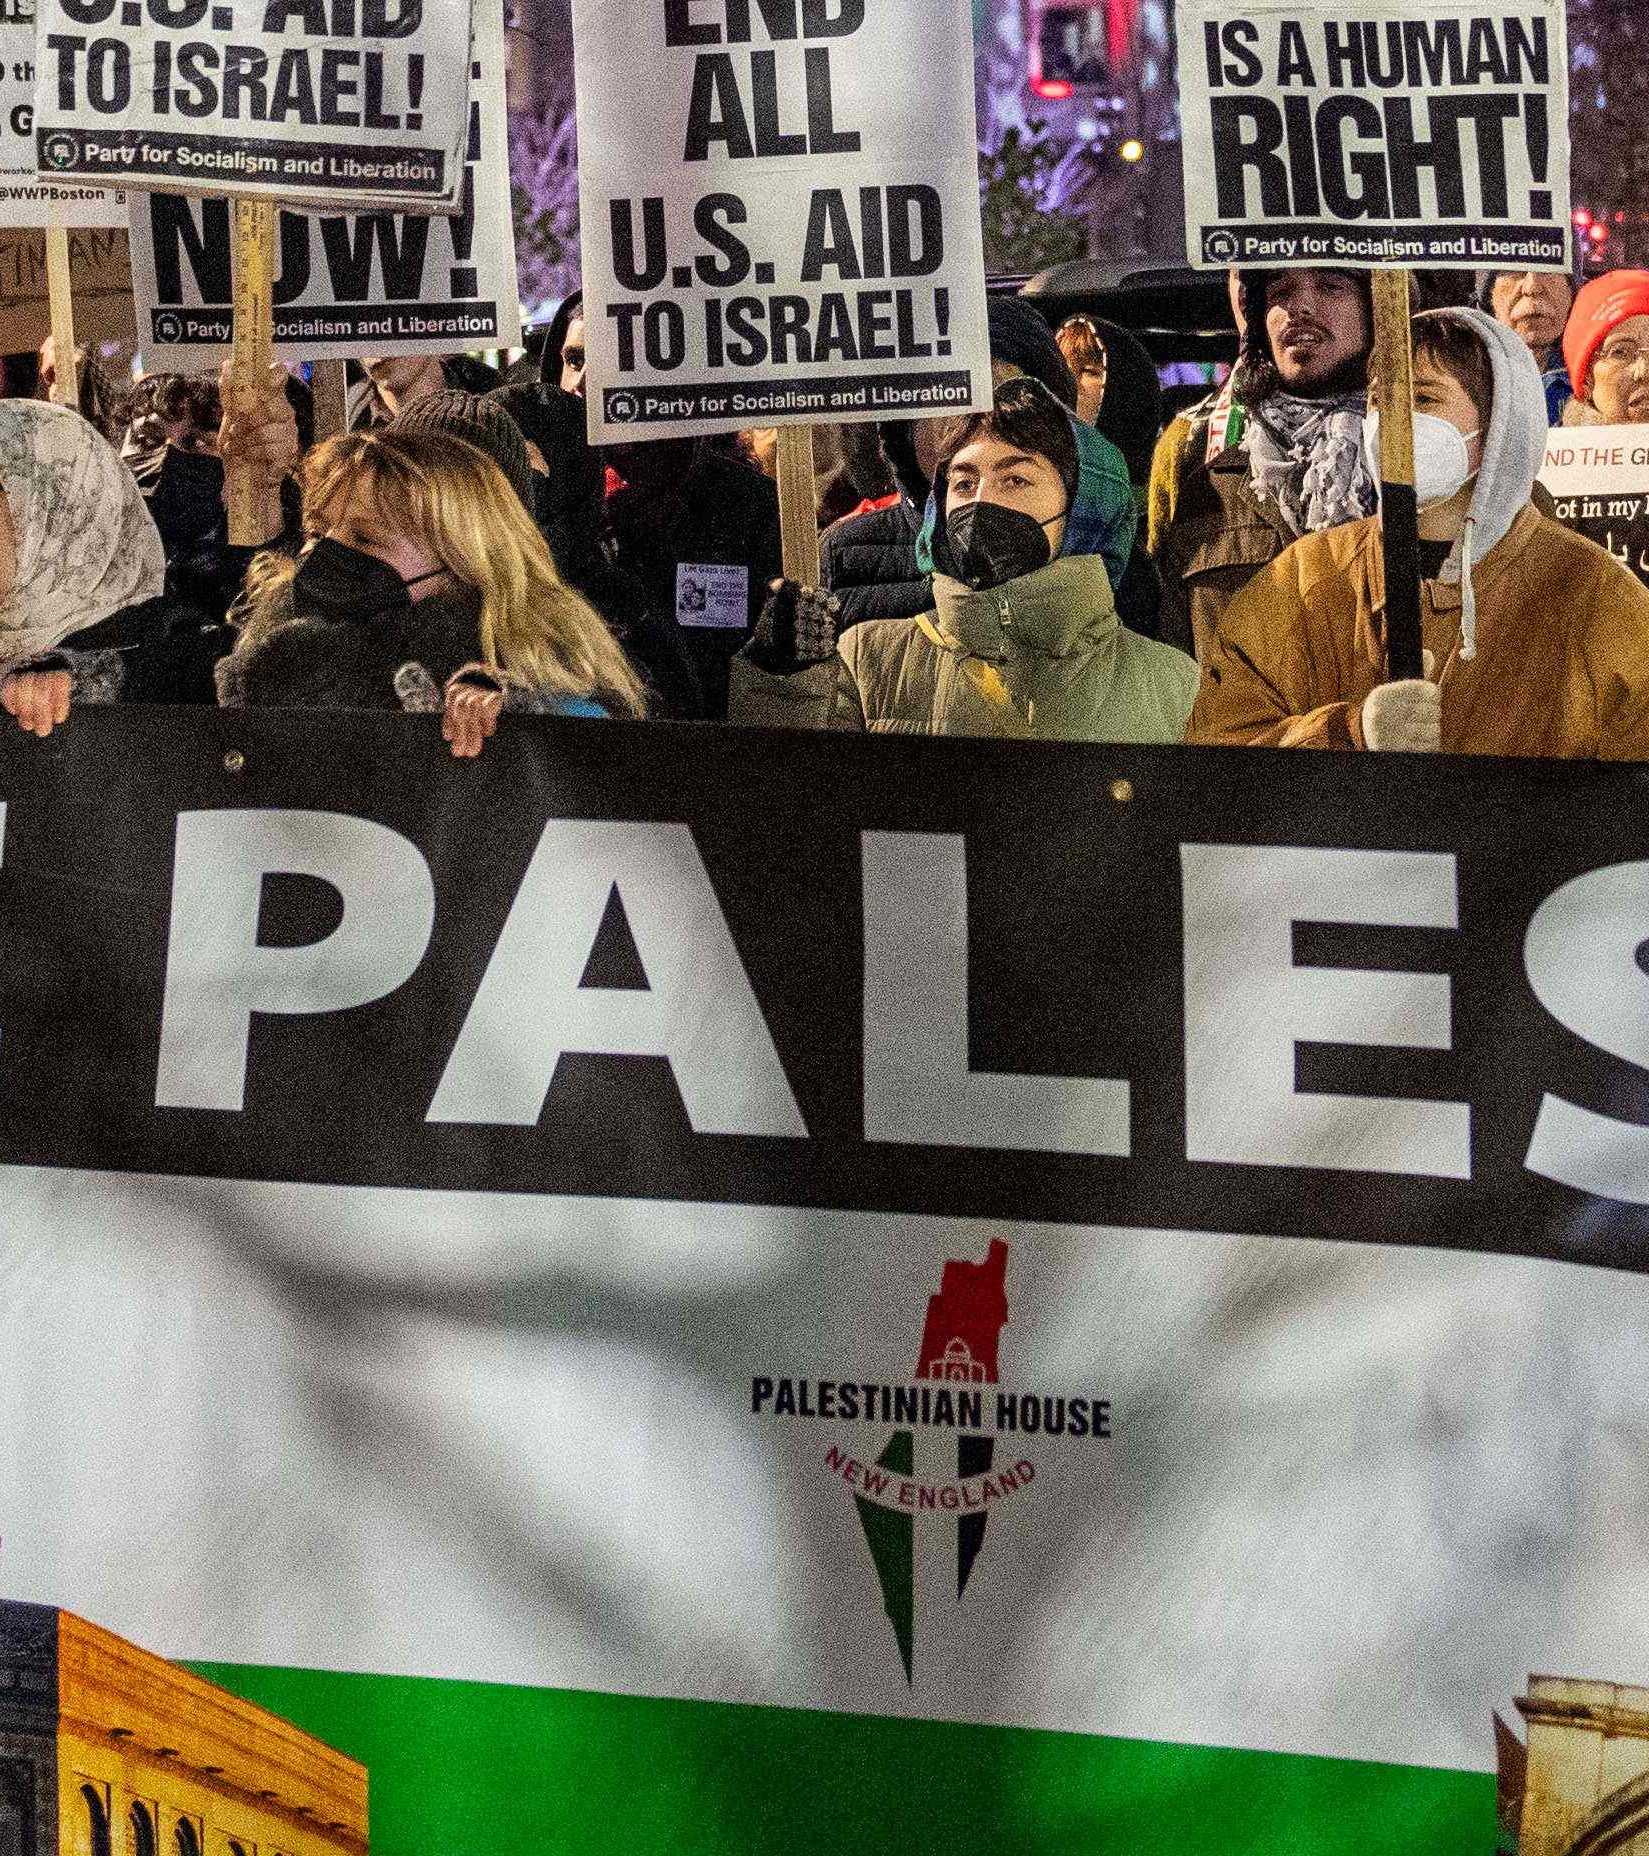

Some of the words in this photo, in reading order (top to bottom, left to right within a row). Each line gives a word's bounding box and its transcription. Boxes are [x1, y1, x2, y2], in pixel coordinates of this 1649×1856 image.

[13, 61, 35, 82] th
[1203, 20, 1263, 87] IS
[1277, 20, 1315, 86] A
[1325, 17, 1549, 87] HUMAN
[47, 35, 133, 114] TO
[152, 40, 425, 130] ISRAEL!
[684, 47, 861, 162] ALL
[85, 142, 137, 166] Party
[142, 144, 172, 165] for
[176, 147, 279, 174] Socialism
[284, 154, 325, 175] and
[330, 156, 437, 181] Liberation
[1210, 93, 1553, 220] RIGHT!
[610, 192, 775, 291] U.S.
[800, 184, 943, 283] AID
[1245, 238, 1298, 259] Party
[1303, 237, 1330, 255] for
[1334, 237, 1423, 256] Socialism
[1428, 237, 1465, 255] and
[1470, 236, 1562, 257] Liberation
[186, 320, 231, 340] Party
[356, 316, 393, 335] and
[397, 312, 495, 335] Liberation
[606, 300, 686, 372] TO
[706, 287, 952, 367] ISRAEL!
[644, 396, 696, 420] Party
[699, 395, 728, 412] for
[732, 387, 826, 412] Socialism
[830, 387, 868, 405] and
[871, 383, 968, 404] Liberation
[1545, 448, 1576, 466] ND
[1580, 447, 1624, 466] THE
[1554, 497, 1577, 519] ot
[1582, 496, 1603, 518] in
[1607, 500, 1642, 522] my
[752, 1377, 982, 1428] PALESTINIAN
[996, 1394, 1112, 1438] HOUSE
[826, 1445, 889, 1498] NEW
[898, 1459, 1037, 1511] ENGLAND
